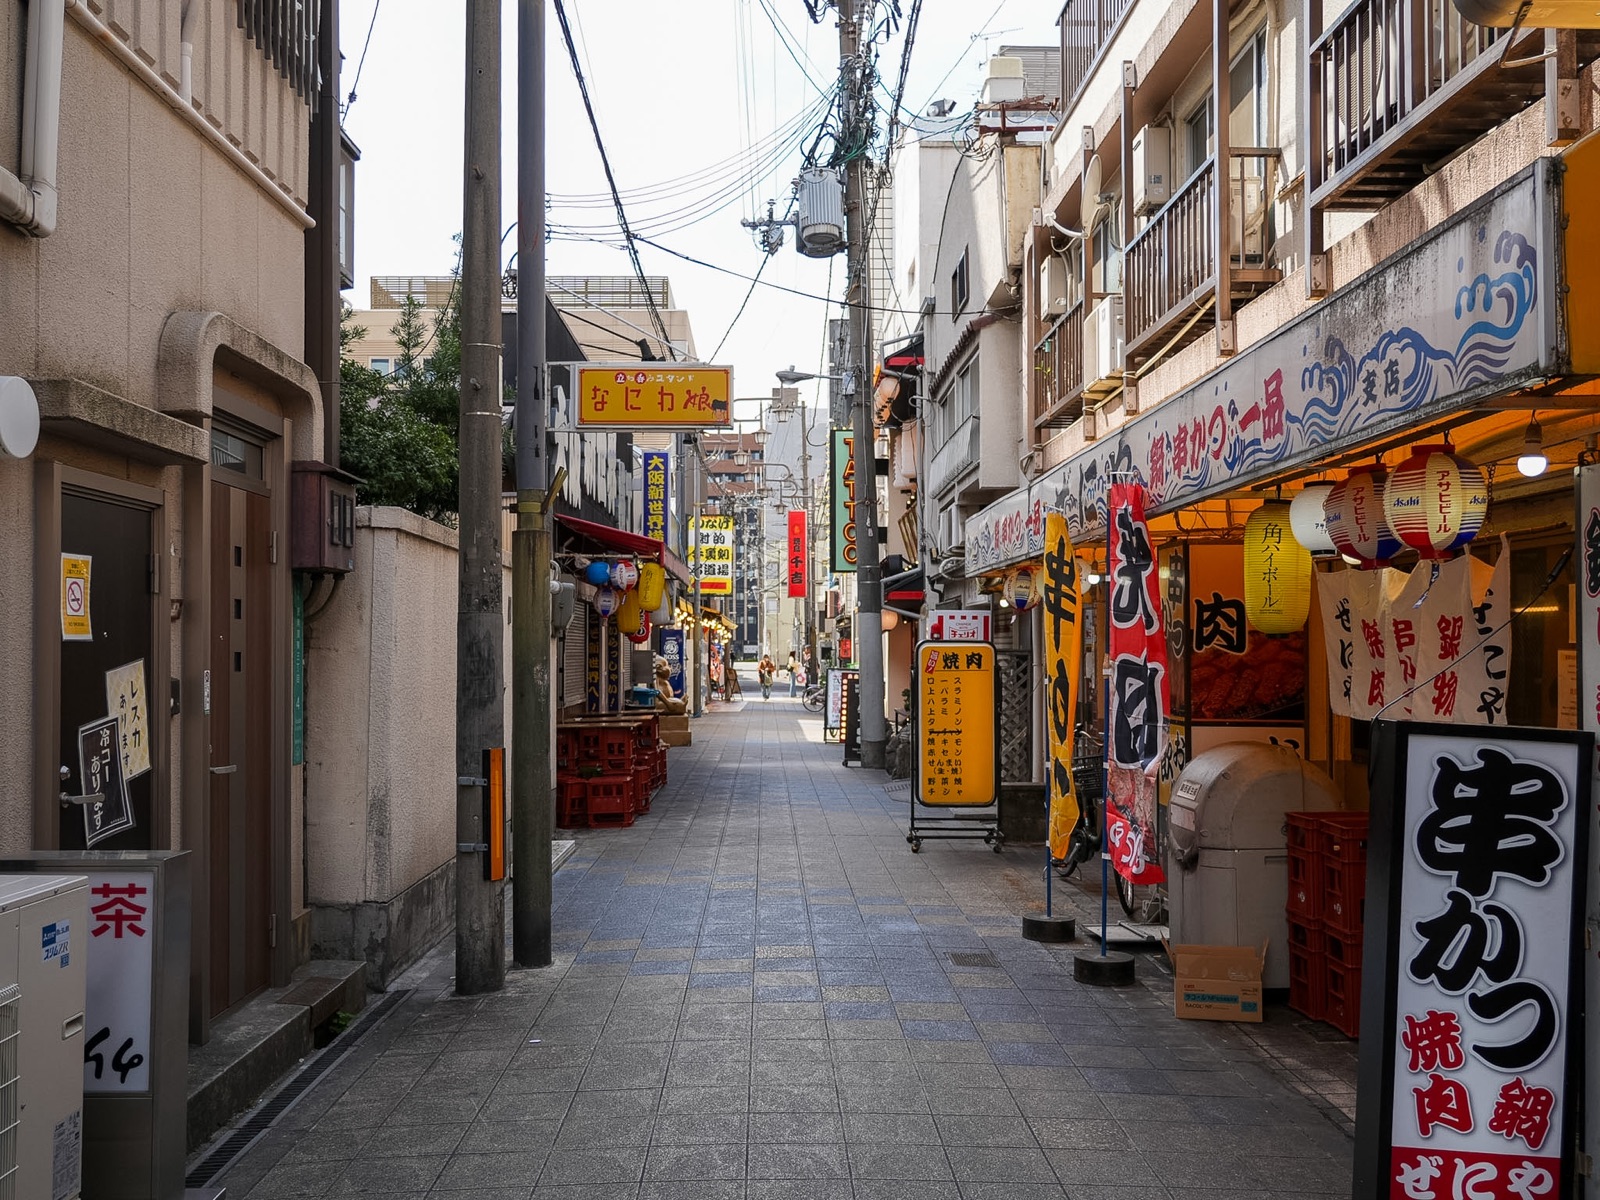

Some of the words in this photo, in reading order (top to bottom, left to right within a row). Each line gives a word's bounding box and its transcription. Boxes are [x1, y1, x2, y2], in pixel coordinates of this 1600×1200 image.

[1362, 358, 1399, 407] 支店
[1353, 486, 1370, 543] アサヒビール
[1393, 495, 1420, 508] Asahi
[1437, 470, 1451, 533] アサヒビール
[1261, 523, 1283, 608] 角ハイボール
[951, 630, 976, 638] チェリオ
[1195, 592, 1247, 653] 肉
[927, 677, 962, 685] ロース
[942, 651, 983, 670] 焼肉
[130, 680, 141, 749] レスカ
[927, 697, 962, 705] ハラミ
[927, 707, 962, 716] 上ミノ
[927, 718, 962, 726] タン
[100, 728, 111, 783] 冷コー
[928, 758, 962, 768] せんまい
[91, 883, 147, 938] 茶
[1408, 746, 1567, 1072] 串かつ
[1402, 1010, 1474, 1137] 焼肉
[1489, 1077, 1556, 1150] 鍋
[1396, 1155, 1554, 1199] ぜにや
